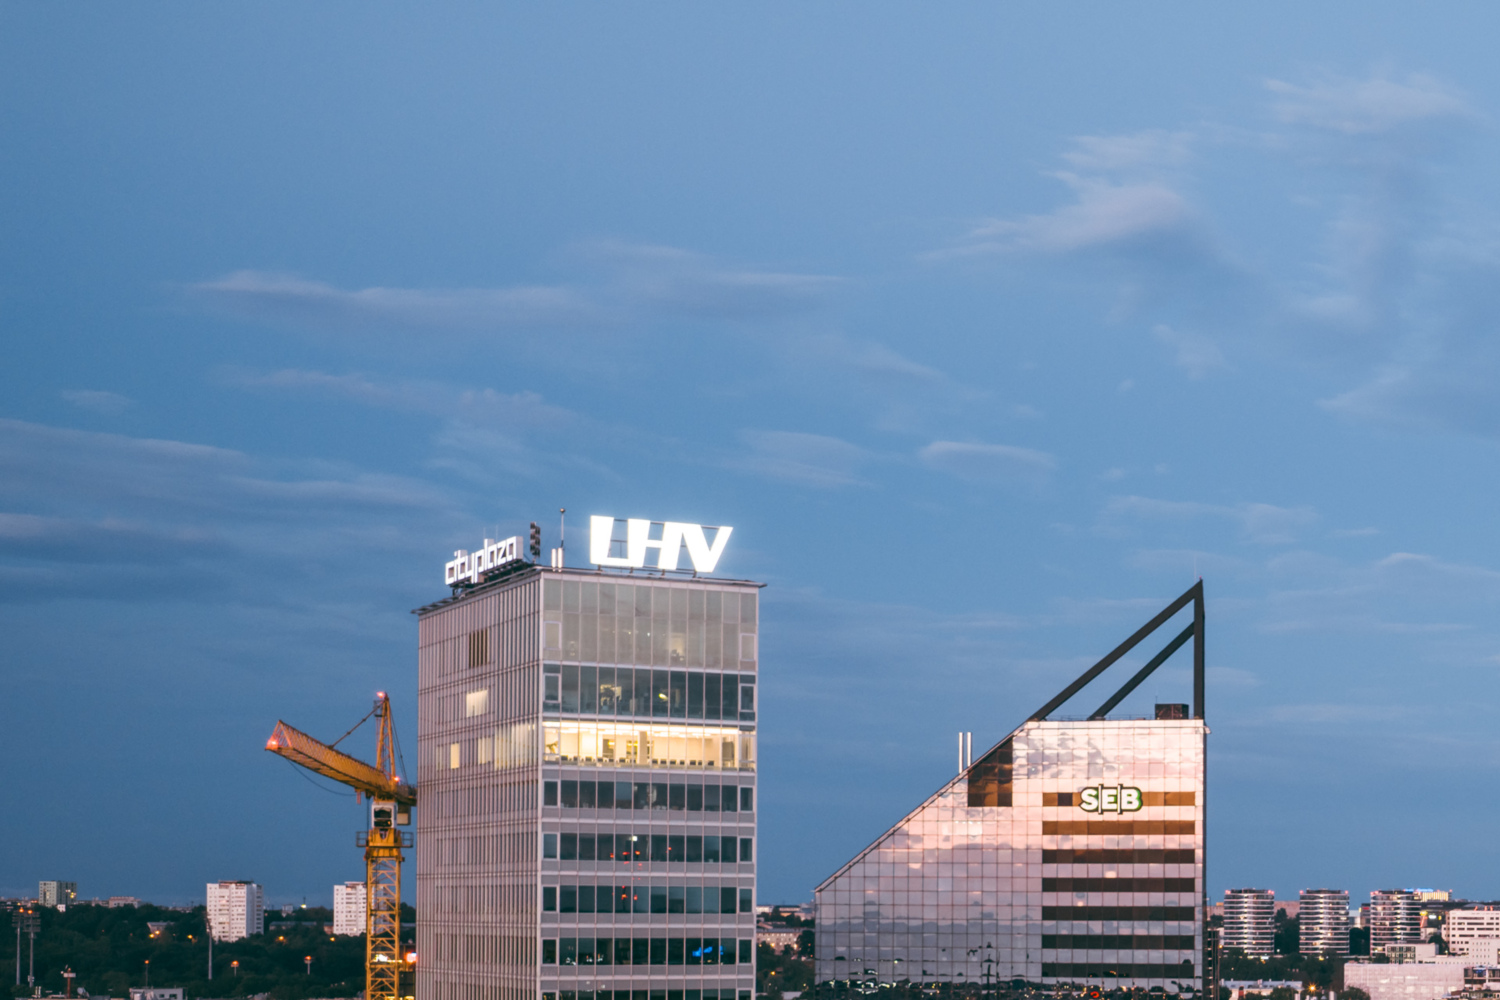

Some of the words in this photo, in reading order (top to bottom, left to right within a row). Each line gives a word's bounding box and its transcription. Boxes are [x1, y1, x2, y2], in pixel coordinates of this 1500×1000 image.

[445, 536, 523, 585] cityplaza
[590, 515, 733, 573] LHV
[1079, 784, 1143, 814] SEB
